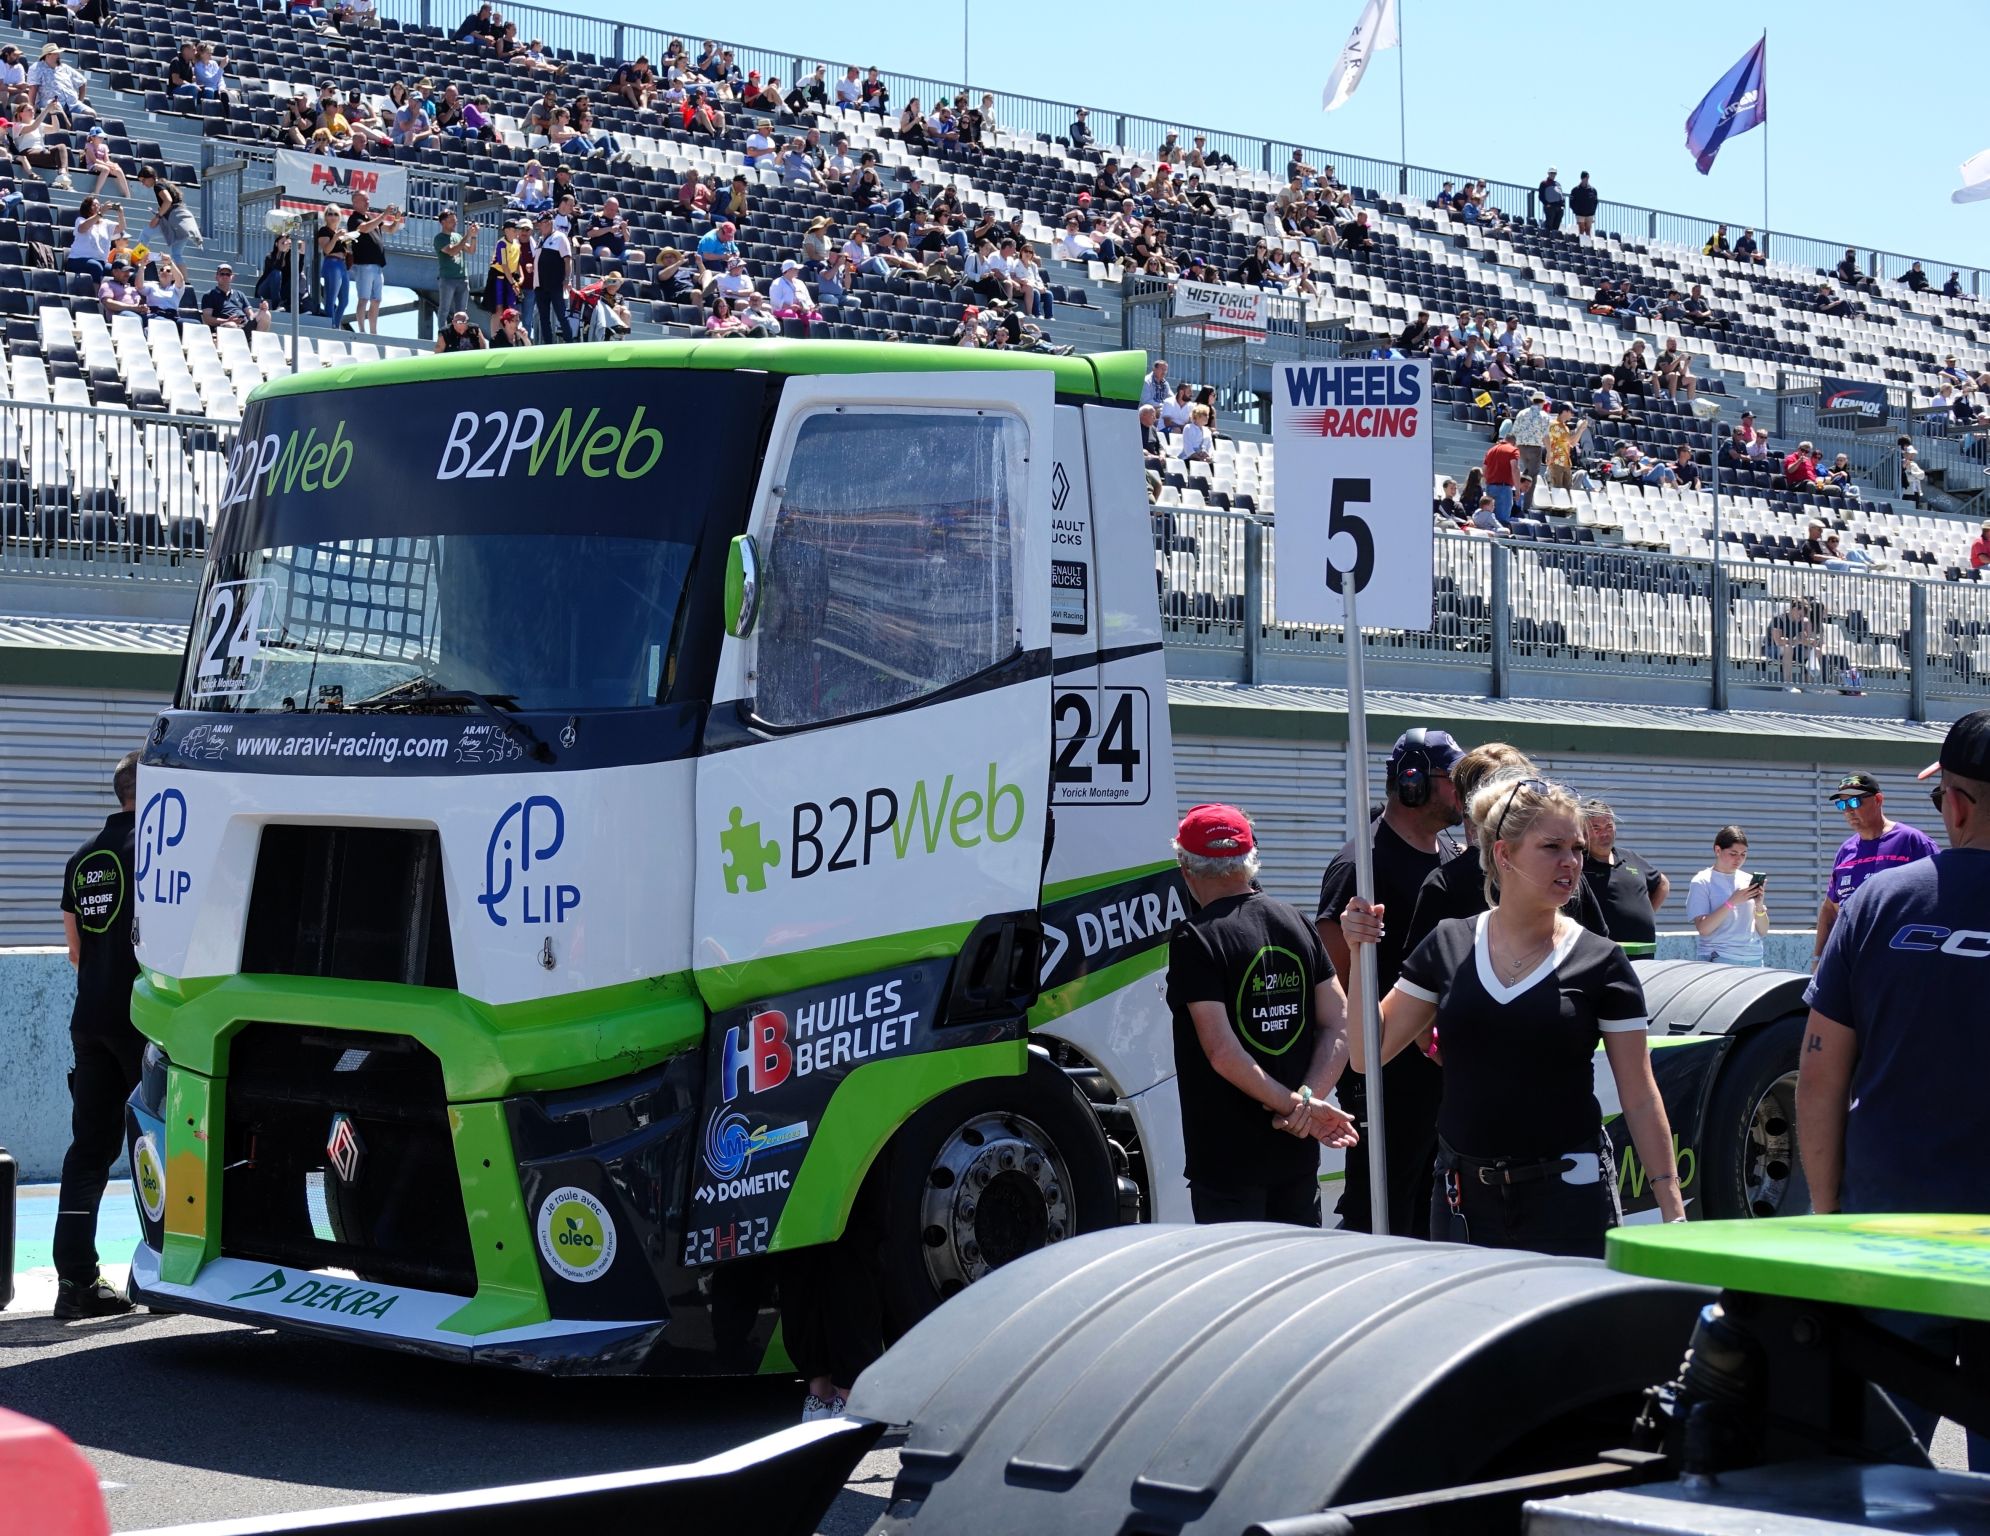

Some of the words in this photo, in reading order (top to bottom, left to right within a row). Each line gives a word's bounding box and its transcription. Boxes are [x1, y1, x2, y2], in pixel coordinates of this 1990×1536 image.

[1187, 287, 1253, 309] HISTORIC
[1218, 306, 1257, 321] TOUR
[1284, 364, 1421, 407] WHEELS
[1830, 397, 1881, 414] KENNOL
[1321, 408, 1419, 438] RACING
[436, 406, 665, 480] B2PWeb
[219, 420, 354, 510] B2PWeb
[1325, 478, 1375, 595] 5
[1052, 565, 1082, 577] ENAULT
[1052, 574, 1082, 586] RUCKS
[198, 584, 266, 678] 24
[1063, 611, 1084, 621] Racing
[212, 724, 234, 734] ARAVI
[462, 725, 490, 735] ARAVI
[1055, 693, 1141, 783] 24
[236, 731, 449, 763] www.aravi-racing.com
[1062, 787, 1087, 798] Yorick
[1089, 787, 1129, 799] Montagne
[791, 762, 1025, 879] B2PWeb
[87, 868, 117, 884] B2PWeb
[155, 868, 191, 905] LIP
[84, 906, 96, 916] DE
[523, 885, 581, 923] LIP
[1076, 885, 1187, 957] DEKRA
[795, 979, 902, 1040] HUILES
[1252, 1006, 1268, 1018] LA
[721, 1009, 793, 1104] HB
[796, 1011, 919, 1078] BERLIET
[718, 1169, 790, 1202] DOMETIC
[545, 1202, 556, 1216] Je
[555, 1190, 579, 1205] roule
[580, 1195, 602, 1216] avec
[558, 1229, 594, 1246] oleo
[684, 1216, 769, 1266] 22H22
[280, 1280, 400, 1320] DEKRA
